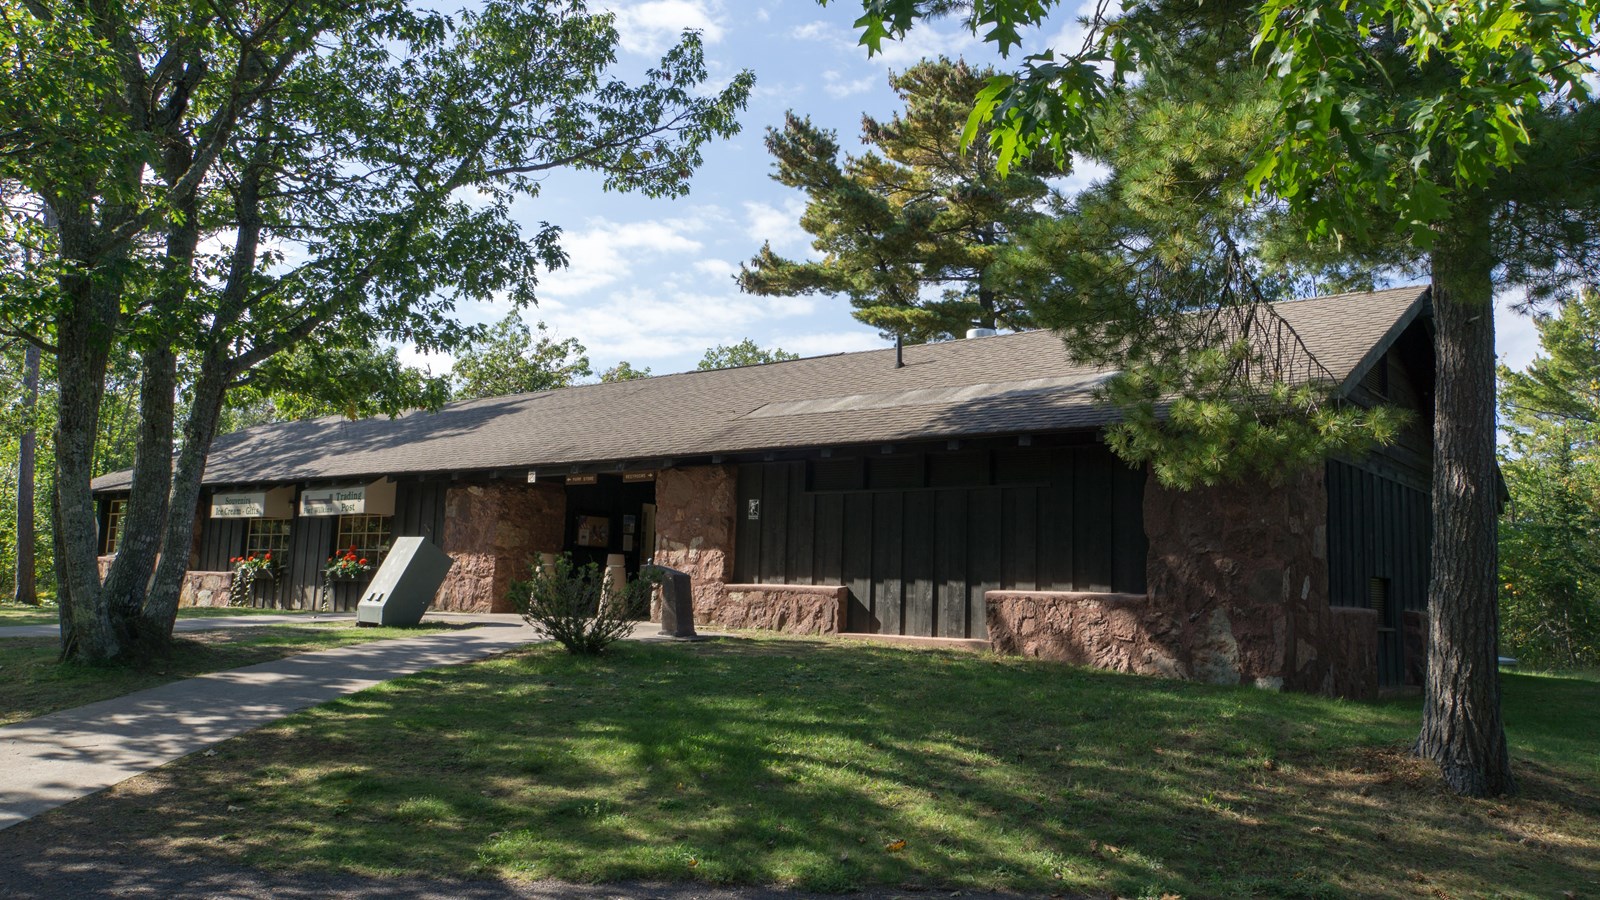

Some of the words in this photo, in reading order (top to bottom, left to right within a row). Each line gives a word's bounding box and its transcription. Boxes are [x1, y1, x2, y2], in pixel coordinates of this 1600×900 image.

[225, 496, 251, 505] Souvenirs
[336, 491, 362, 502] Trading
[215, 507, 224, 516] Ice
[224, 507, 242, 516] Cream
[245, 506, 259, 516] Gifts
[341, 503, 355, 512] Post
